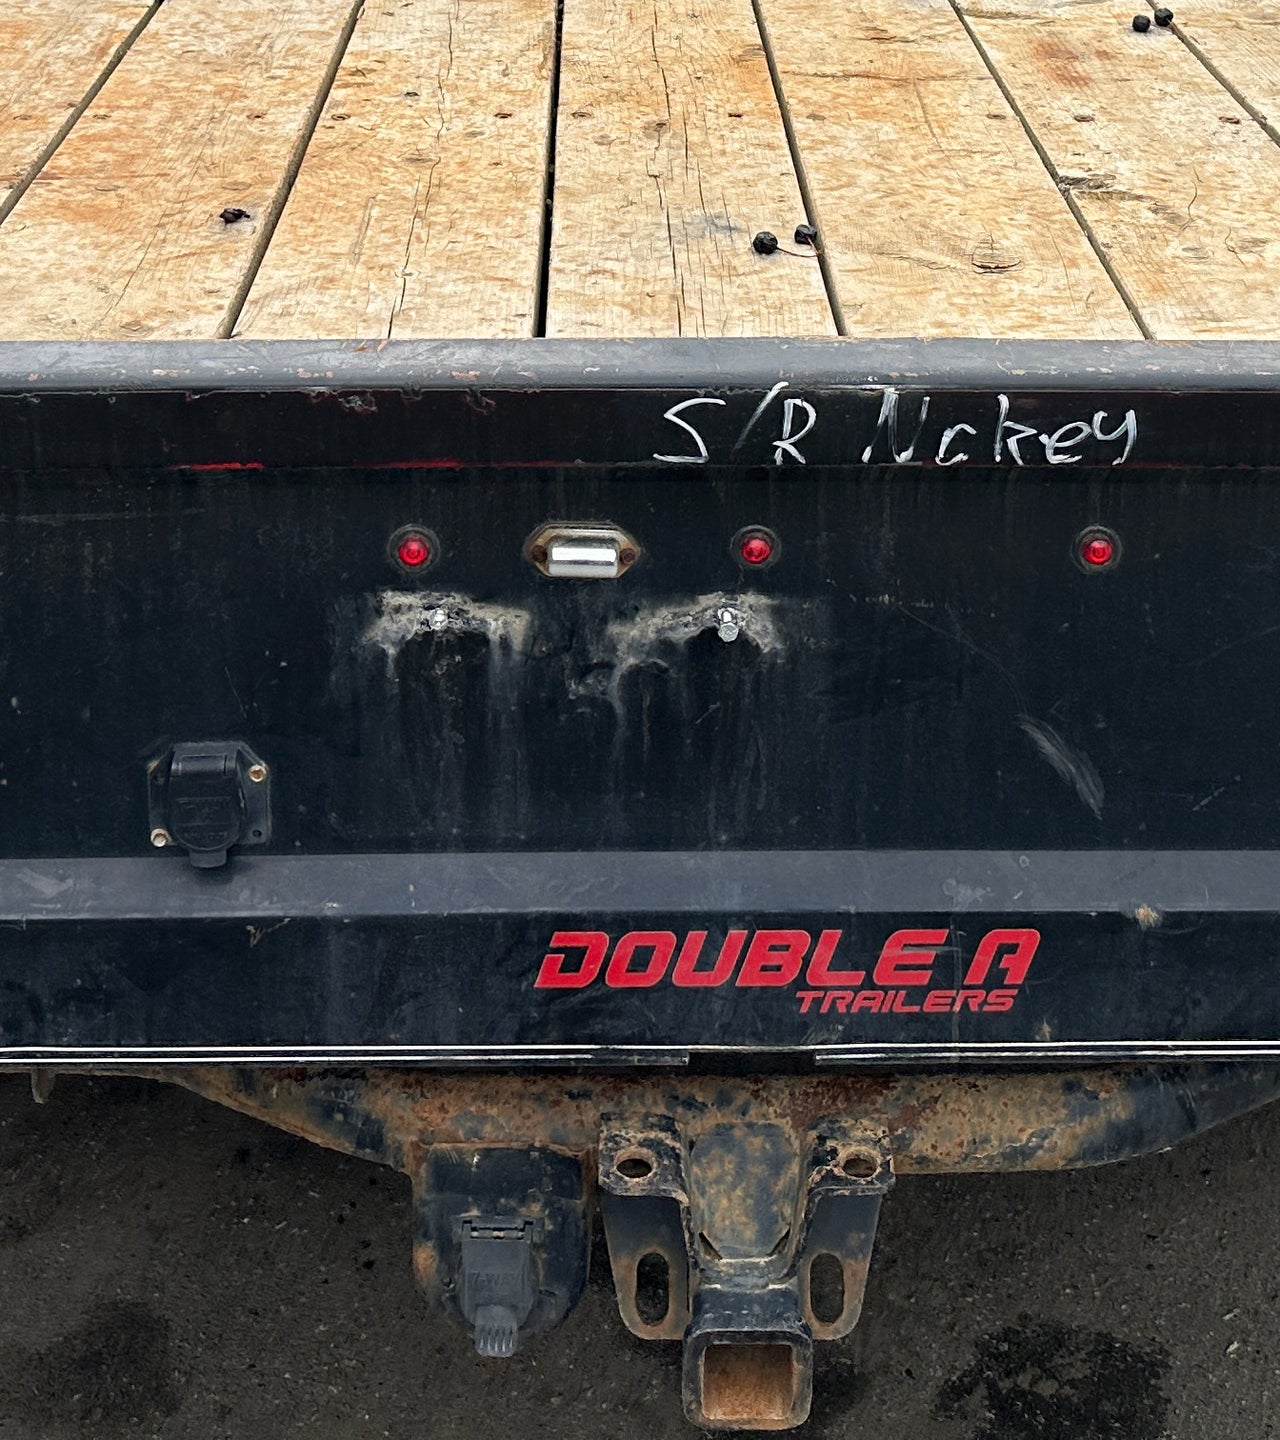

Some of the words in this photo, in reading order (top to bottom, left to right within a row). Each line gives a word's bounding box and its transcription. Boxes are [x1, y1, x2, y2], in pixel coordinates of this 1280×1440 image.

[653, 381, 819, 465] S/R
[534, 929, 950, 989] DOUBLE
[964, 928, 1041, 986] A
[794, 989, 1019, 1014] TRAILERS
